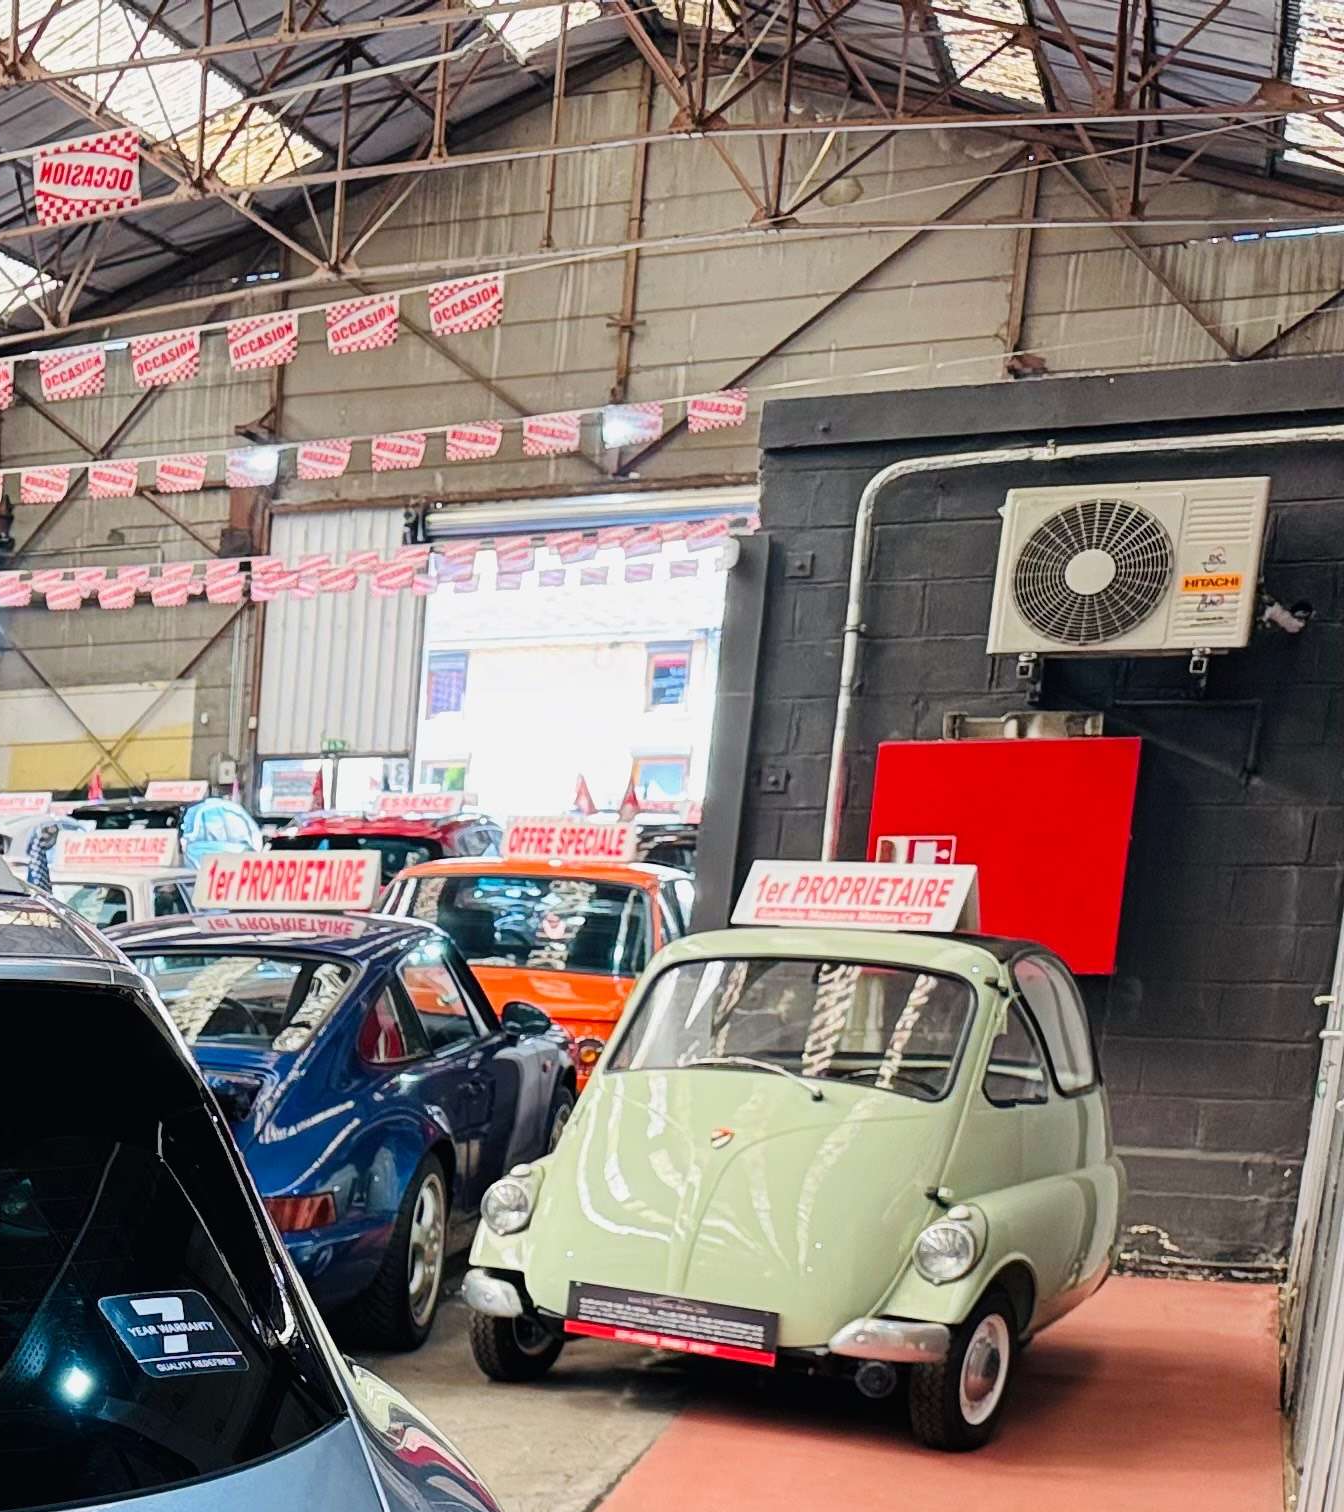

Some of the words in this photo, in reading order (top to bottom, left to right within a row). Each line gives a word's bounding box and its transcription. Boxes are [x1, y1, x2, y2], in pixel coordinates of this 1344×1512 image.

[434, 284, 500, 325] OCCASION
[233, 321, 293, 360] OCCASION
[331, 303, 396, 344] OCCASION
[45, 356, 101, 389] OCCASION
[136, 339, 196, 376] OCCASION
[1184, 578, 1239, 588] HITACHI
[508, 826, 555, 855] OFFRE
[556, 826, 628, 856] SPECIALE
[207, 859, 235, 901] 1er
[236, 860, 367, 901] PROPRIETAIRE
[756, 873, 791, 904] 1er
[790, 875, 956, 908] PROPRIETAIRE
[127, 1323, 159, 1337] YEAR
[159, 1320, 215, 1335] WARRANTY
[156, 1360, 193, 1372] QUALITY
[193, 1357, 236, 1369] REDEFINED
